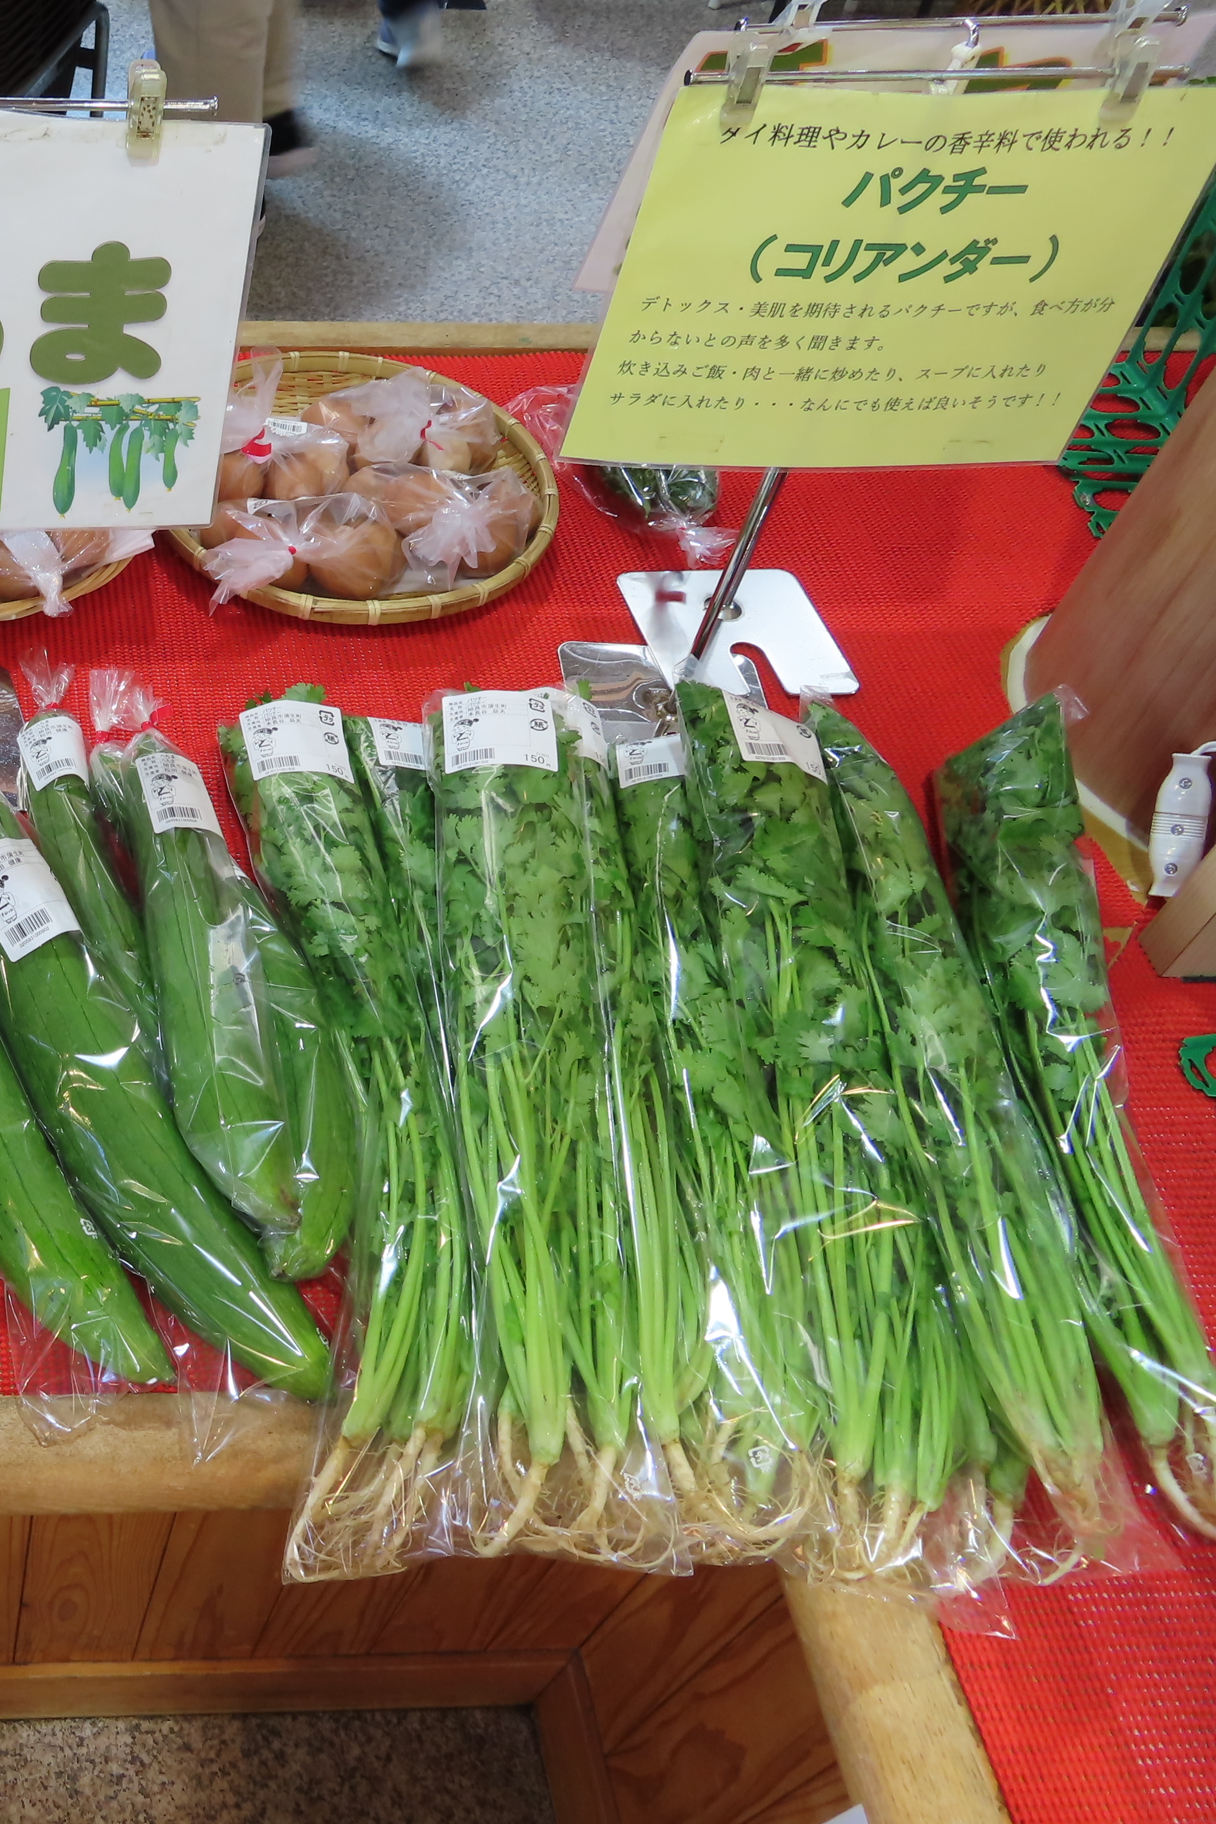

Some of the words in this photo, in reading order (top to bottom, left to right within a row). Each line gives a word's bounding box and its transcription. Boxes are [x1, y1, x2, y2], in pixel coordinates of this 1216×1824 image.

[841, 166, 1029, 215] パクチー
[628, 329, 885, 351] からないとの声を多く聞きます。
